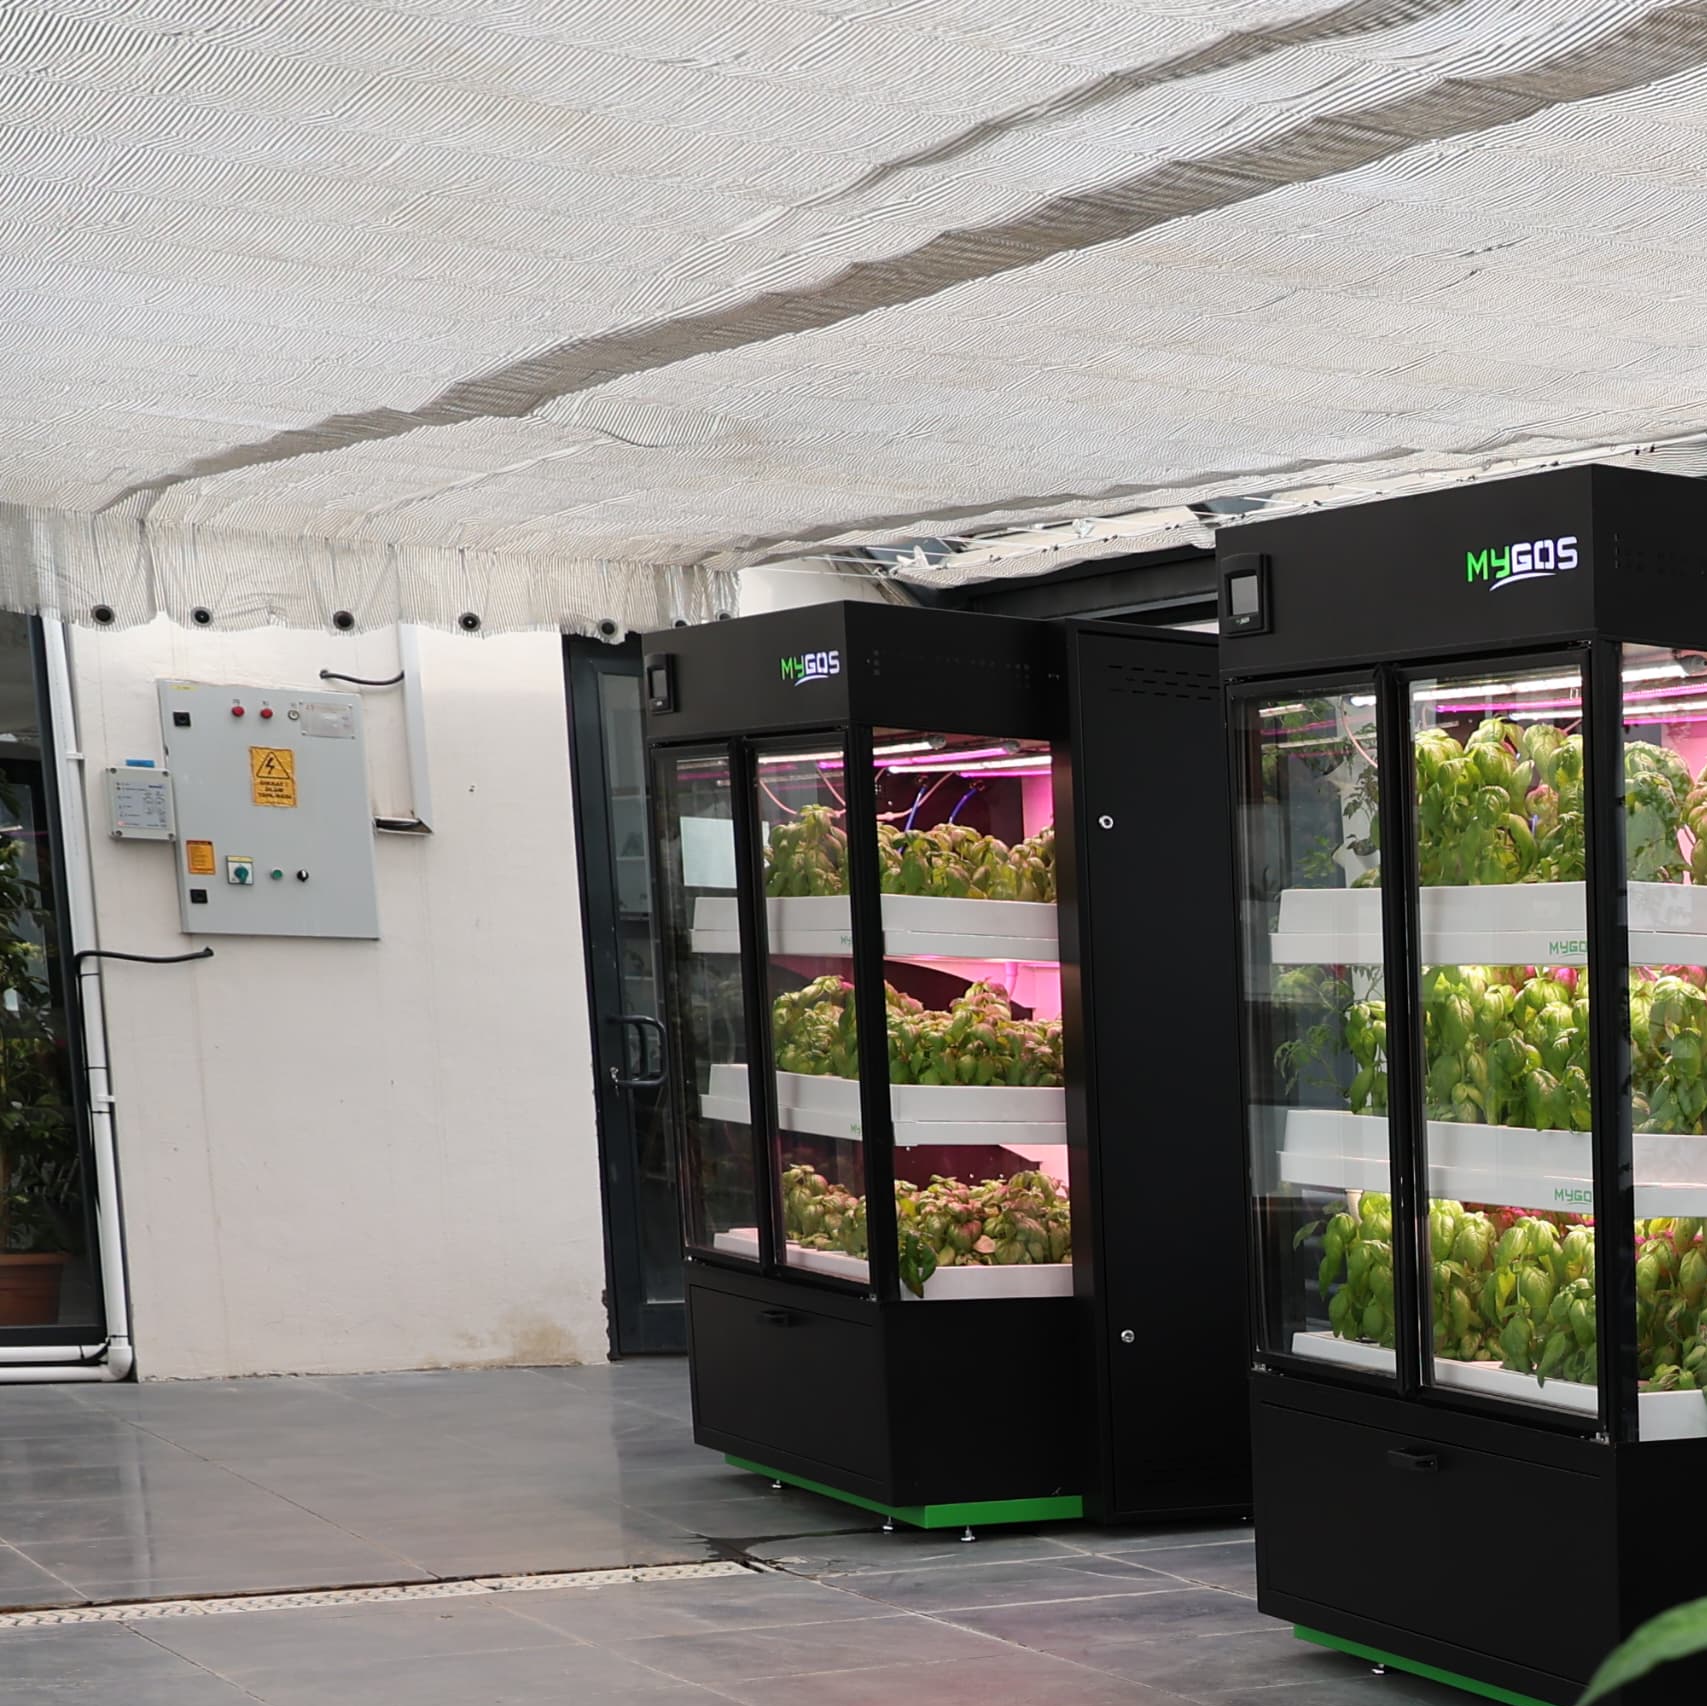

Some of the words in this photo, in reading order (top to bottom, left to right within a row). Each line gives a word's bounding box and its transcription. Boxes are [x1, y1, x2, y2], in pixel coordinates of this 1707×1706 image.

[1466, 536, 1578, 582] MYGOS
[780, 650, 840, 680] MYGOS
[1548, 940, 1588, 954] MYGO
[1554, 1188, 1592, 1202] MYGO
